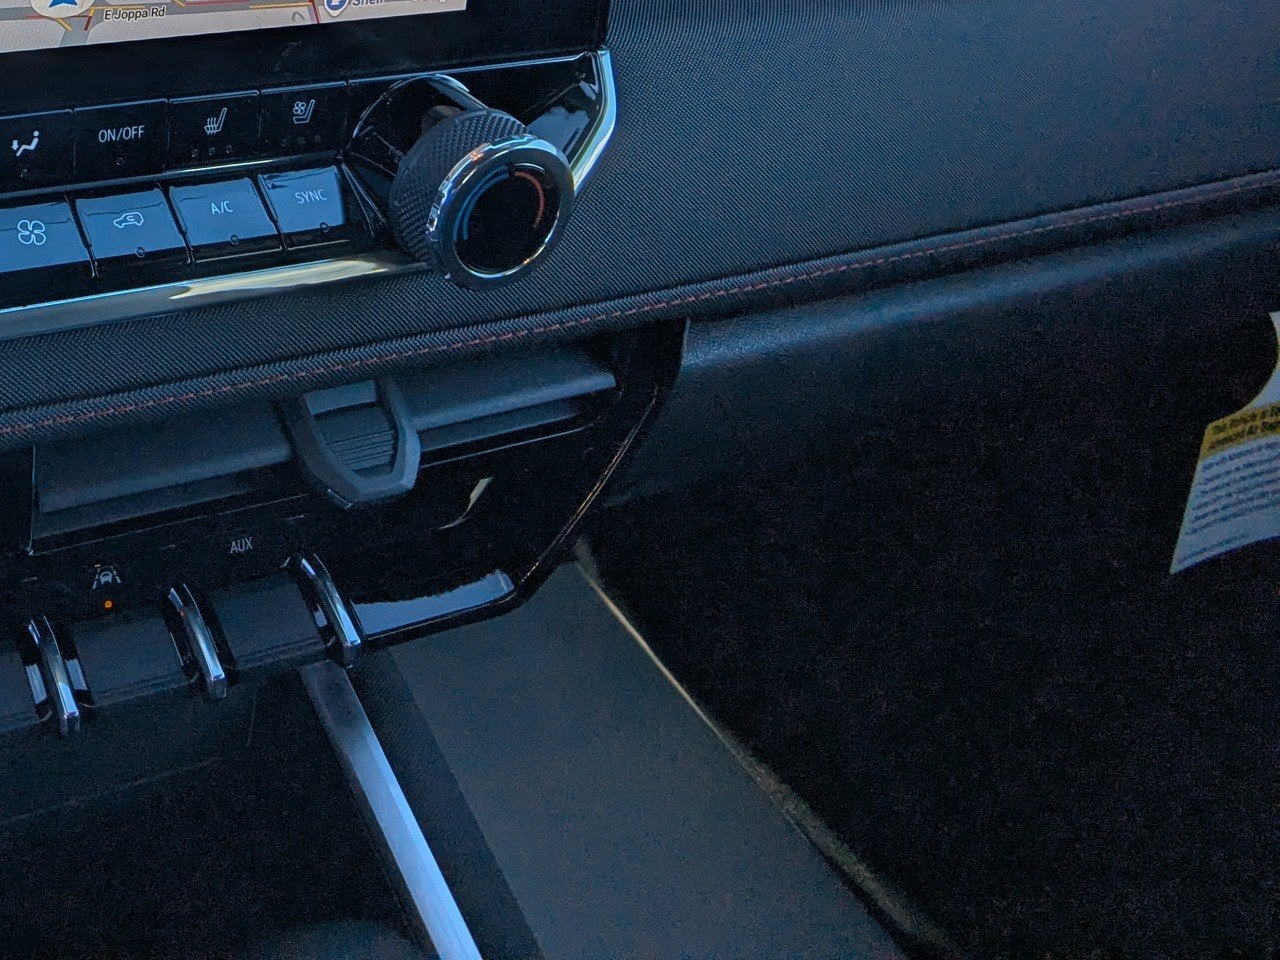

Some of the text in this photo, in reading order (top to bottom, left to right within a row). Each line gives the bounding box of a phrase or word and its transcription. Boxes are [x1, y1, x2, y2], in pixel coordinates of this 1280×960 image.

[104, 7, 165, 22] E Joppa Rd
[98, 125, 145, 143] ON/OFF
[294, 188, 328, 205] SYNC
[210, 200, 234, 216] A/C
[230, 536, 253, 554] AUX
